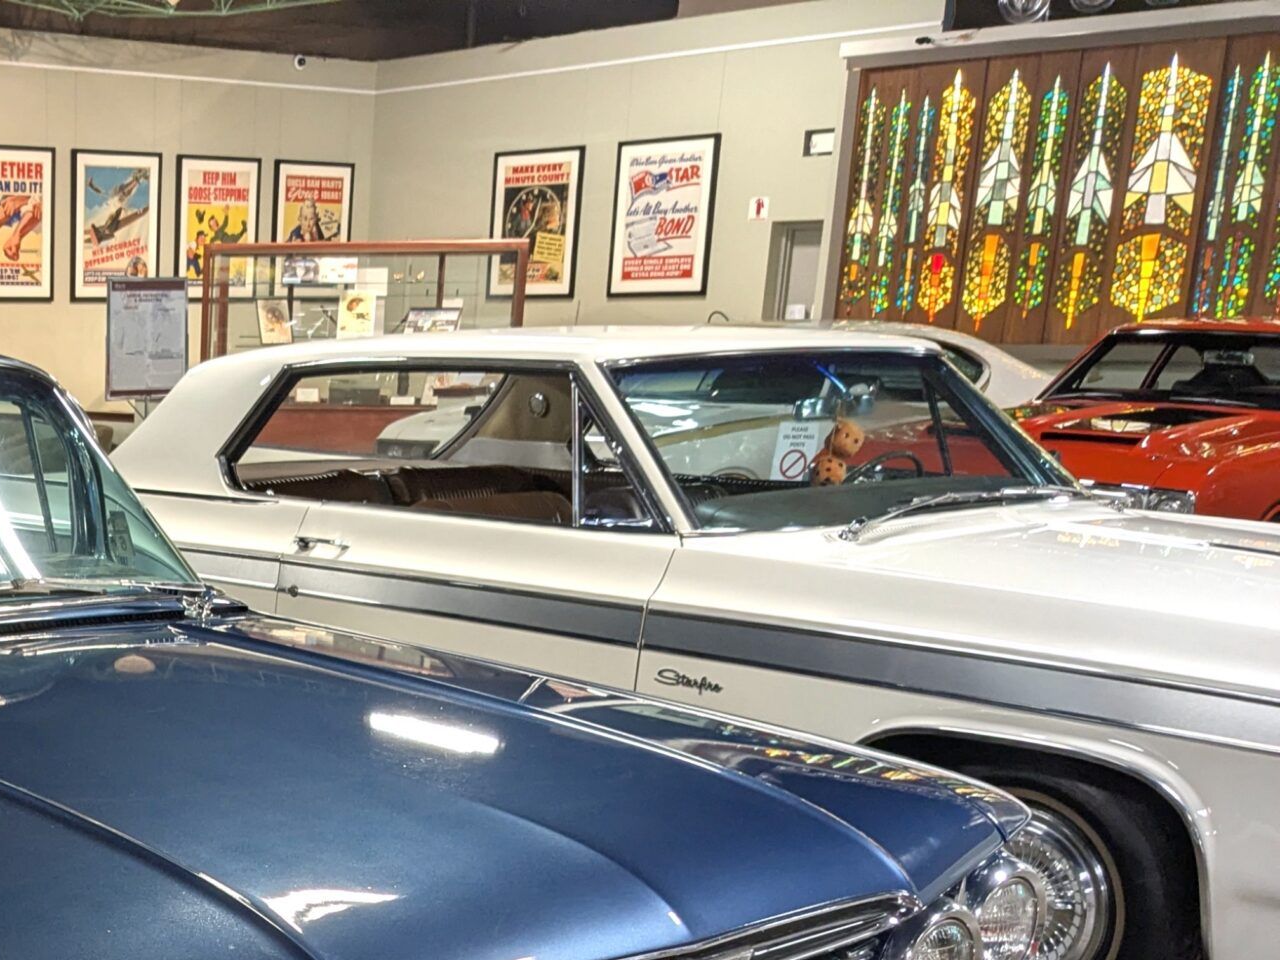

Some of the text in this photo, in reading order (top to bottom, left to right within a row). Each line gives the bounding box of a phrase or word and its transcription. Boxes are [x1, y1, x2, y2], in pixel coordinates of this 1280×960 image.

[512, 163, 564, 174] MAKE EVERY
[668, 165, 700, 182] STAR
[202, 171, 236, 185] KEEP HIM
[287, 178, 342, 189] UNCLE SAM WANTS
[504, 174, 535, 185] MINUTE
[14, 182, 26, 193] DO
[29, 182, 43, 193] IT!
[188, 187, 249, 202] GOOSE-STEPPING!
[652, 201, 668, 215] Buy
[669, 200, 698, 214] Another
[655, 215, 695, 236] BOND
[92, 238, 141, 256] HIS ACCURACY
[84, 254, 114, 268] DEPENDS
[115, 251, 125, 259] ON
[654, 668, 724, 695] Starfire
